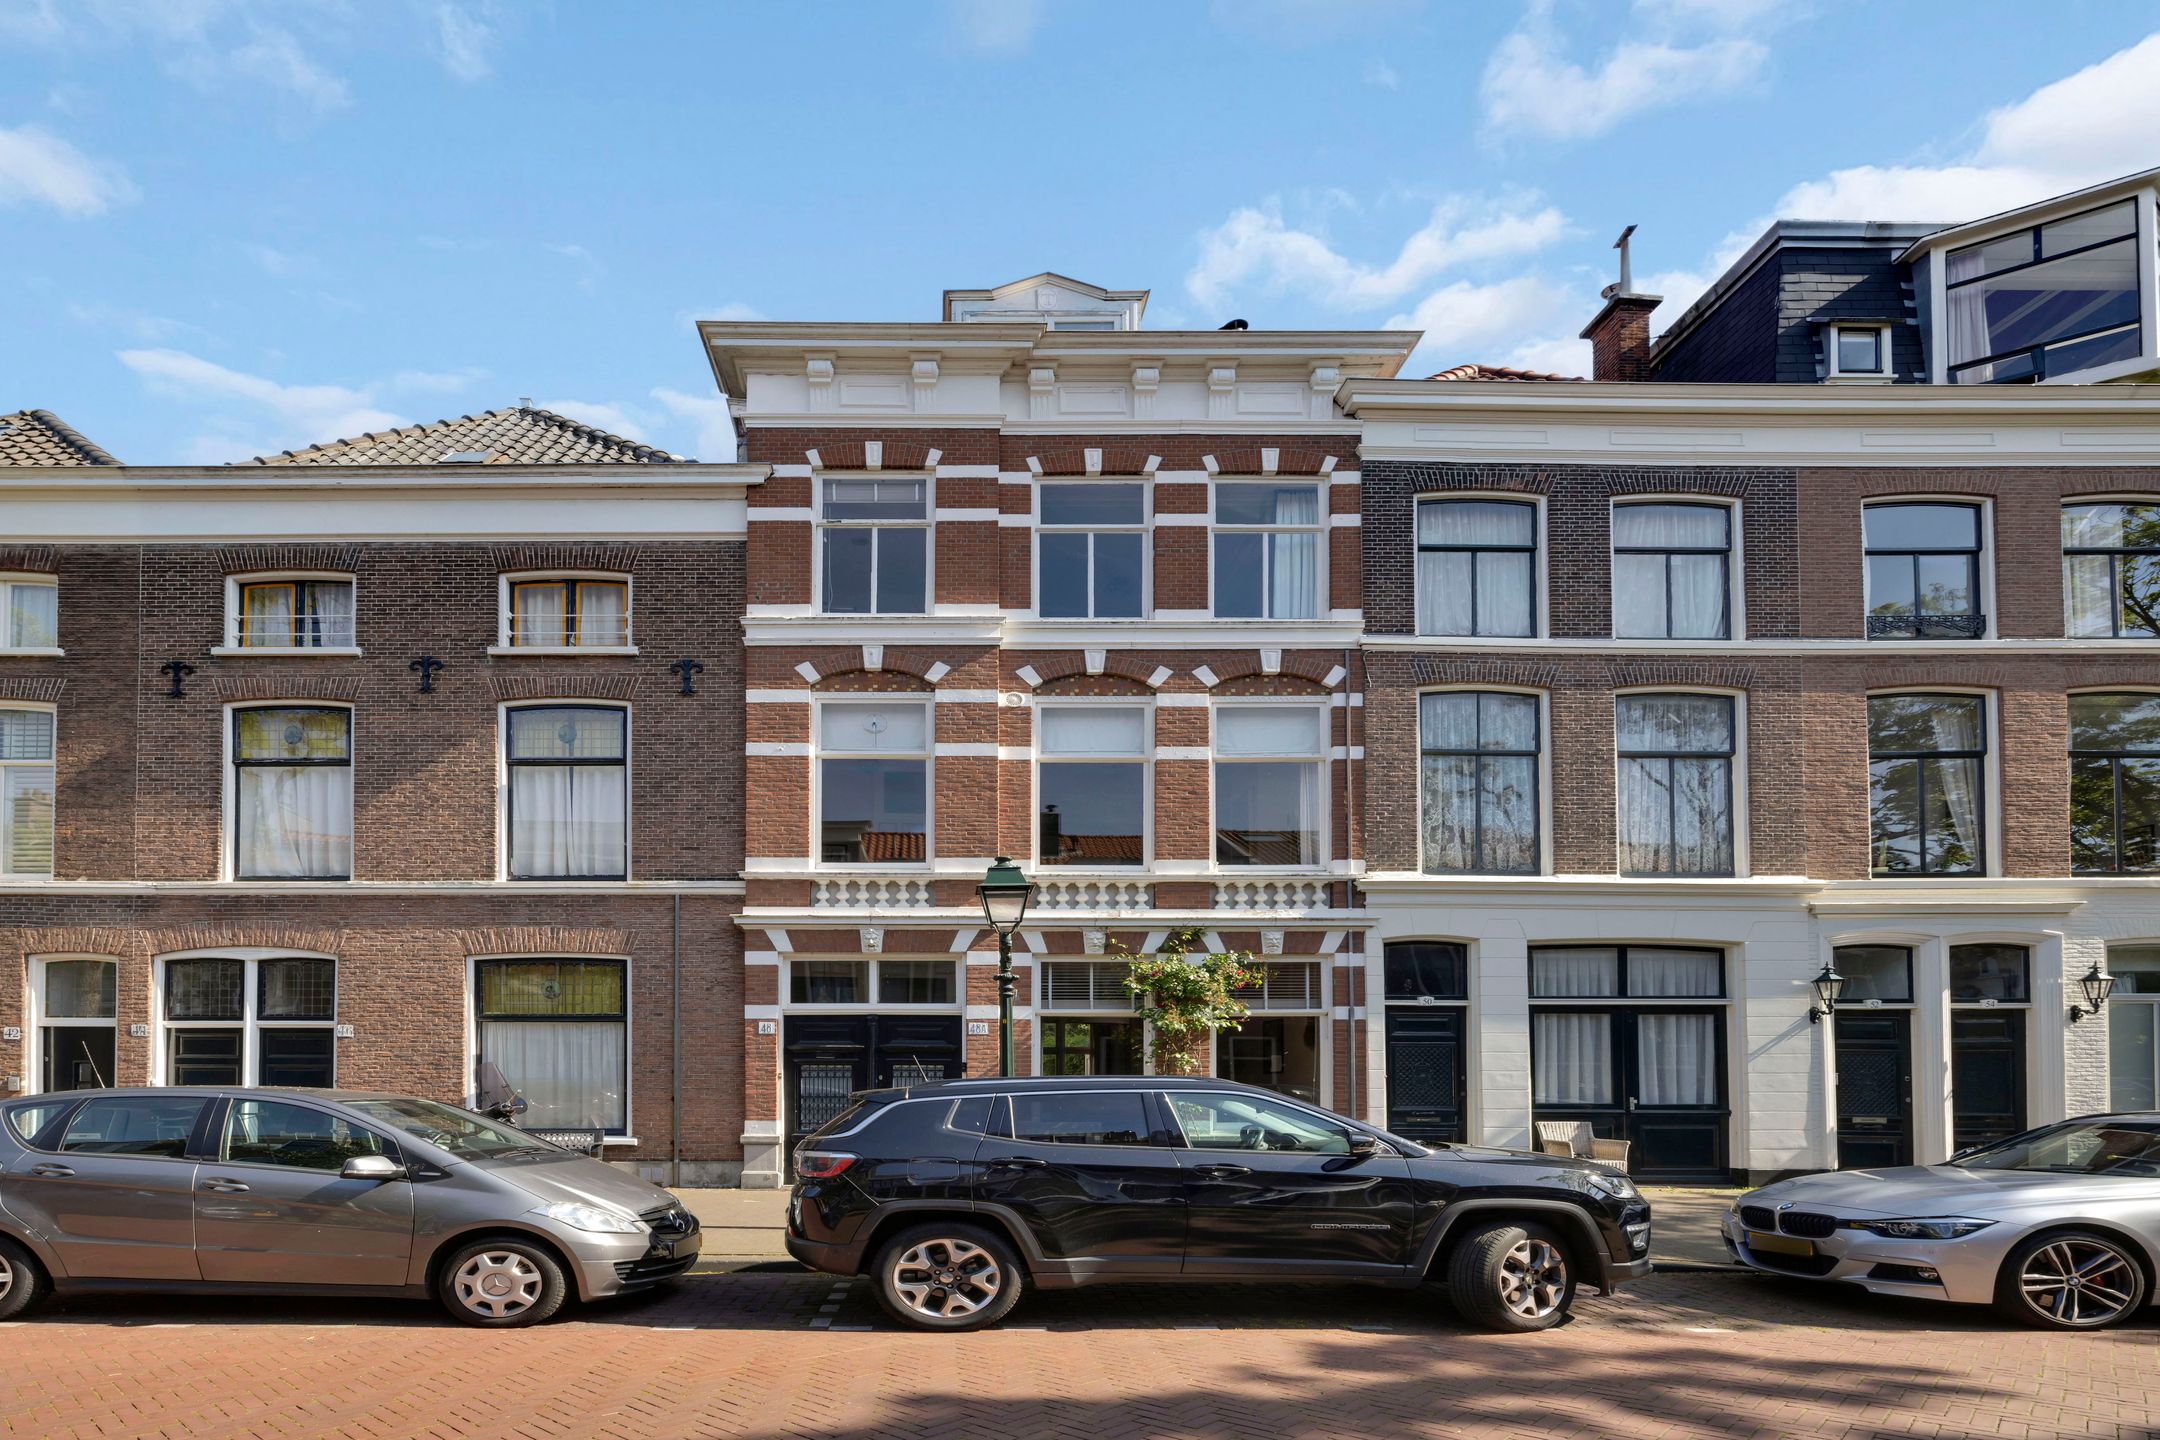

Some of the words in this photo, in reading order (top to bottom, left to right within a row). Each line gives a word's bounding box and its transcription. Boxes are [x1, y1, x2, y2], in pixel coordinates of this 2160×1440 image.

[4, 1028, 19, 1038] 42
[132, 1025, 147, 1036] 44
[337, 1025, 353, 1036] 46
[760, 1023, 772, 1033] 48
[970, 1023, 987, 1033] 48A
